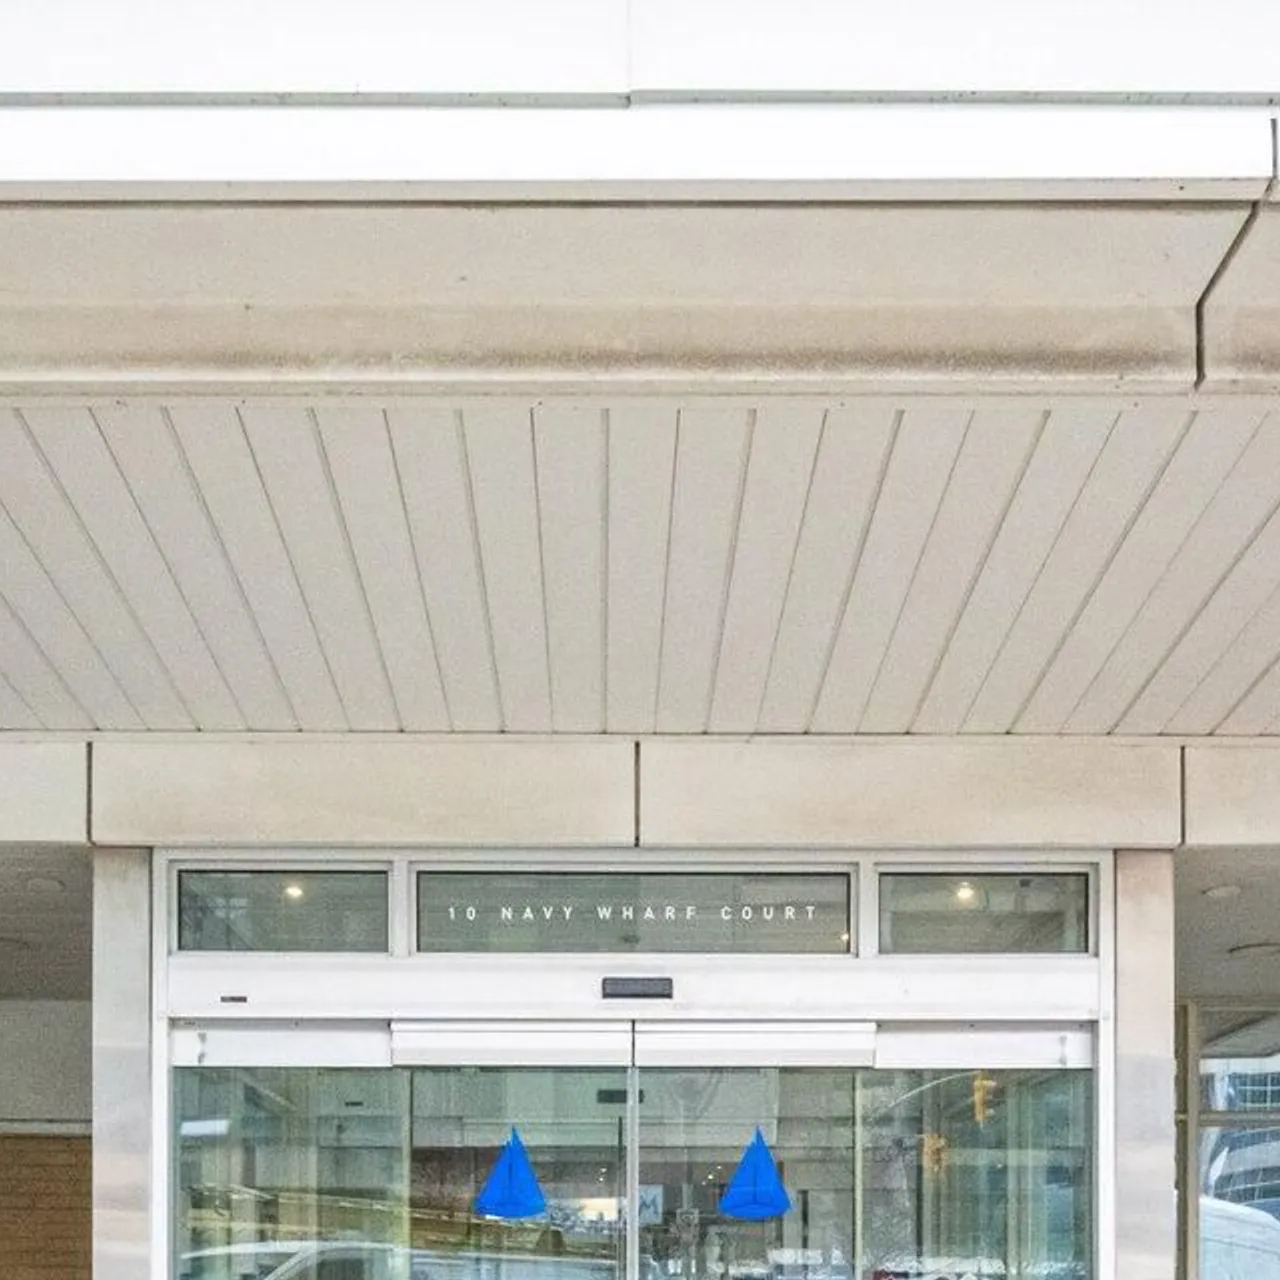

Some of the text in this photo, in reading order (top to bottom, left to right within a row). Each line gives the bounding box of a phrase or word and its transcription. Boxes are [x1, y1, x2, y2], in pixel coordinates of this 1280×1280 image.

[447, 906, 817, 921] 10 NAVY WHARF COURT
